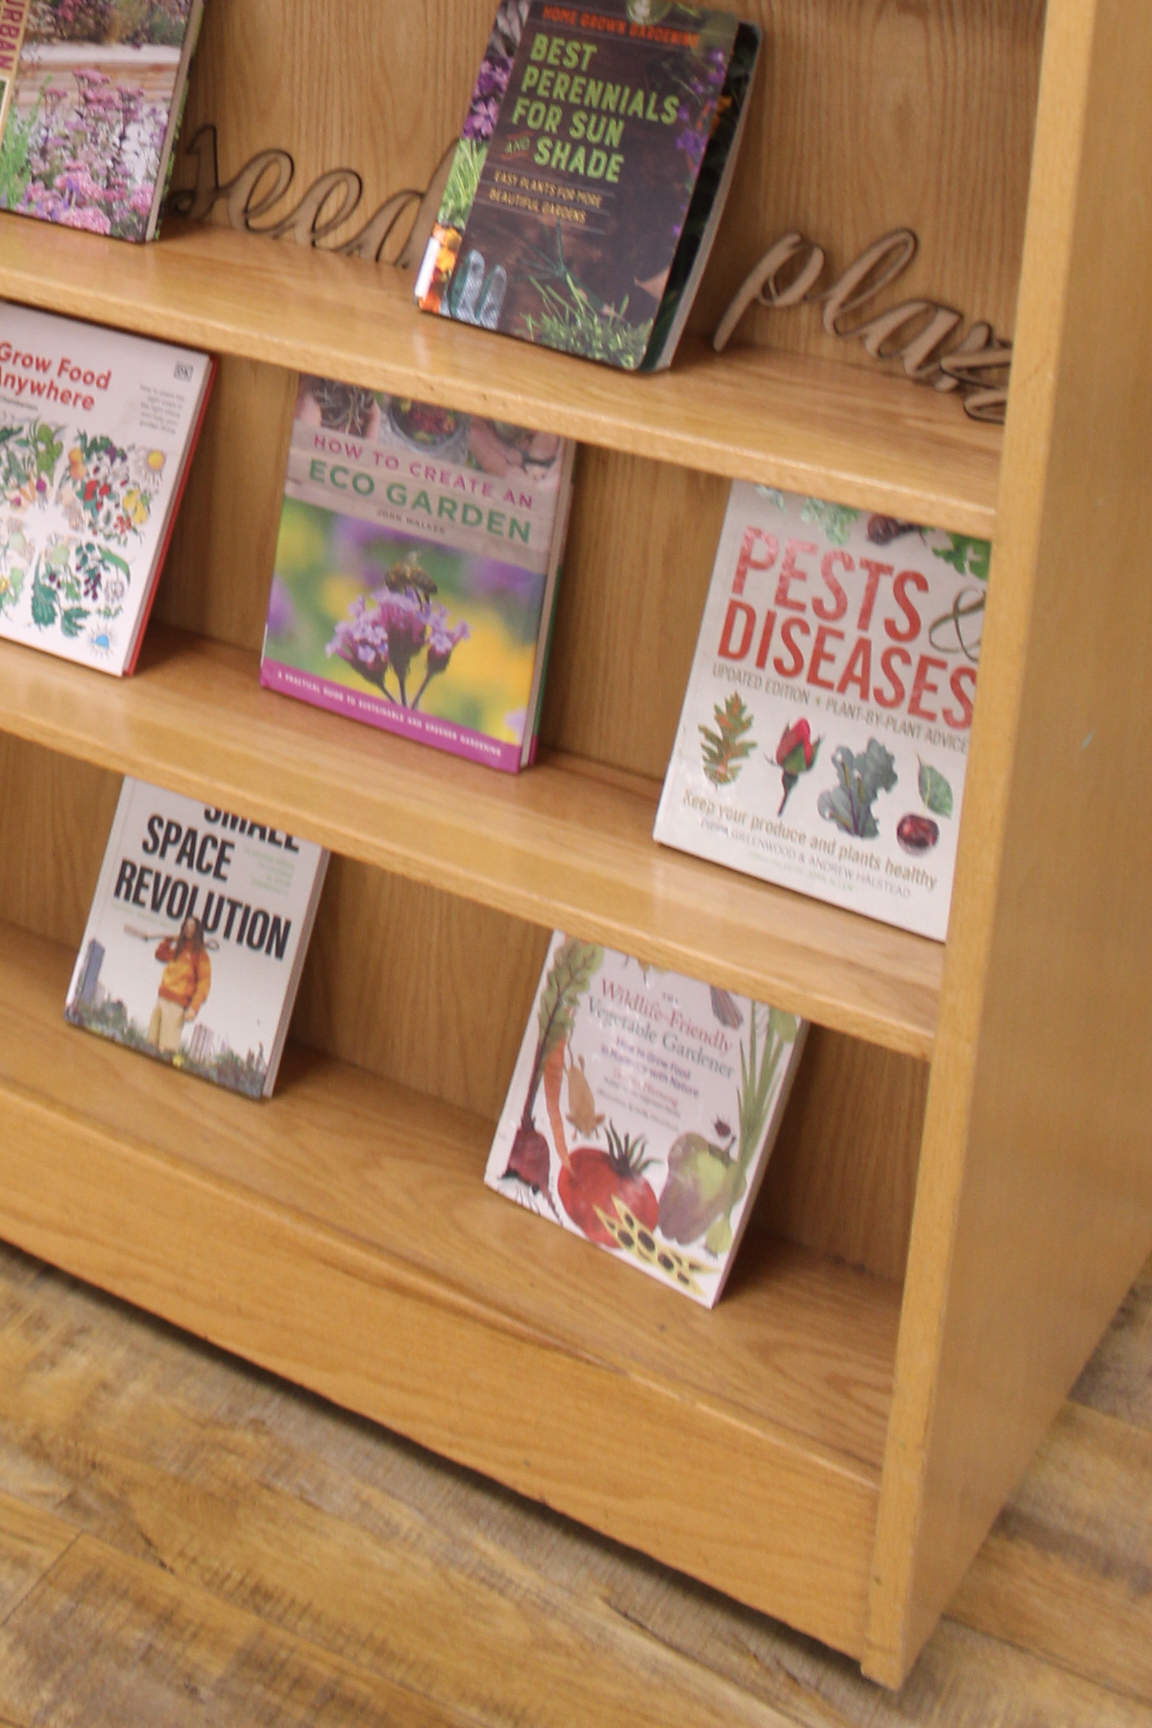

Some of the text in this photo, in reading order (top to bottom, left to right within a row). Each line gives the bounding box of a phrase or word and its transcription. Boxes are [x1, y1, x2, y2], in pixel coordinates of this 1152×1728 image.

[529, 32, 598, 72] BEST
[541, 4, 702, 50] HOME GROWN GARDENING
[510, 96, 626, 149] FOR SUN
[520, 65, 680, 126] PERENNIALS
[493, 168, 518, 187] EASY
[518, 175, 557, 198] PLANTS
[556, 184, 576, 202] FOR
[504, 135, 626, 184] AND SHADE
[488, 186, 586, 225] BEAUTIFUL GARDENS
[56, 357, 112, 391] Food
[308, 457, 532, 545] ECO GARDEN
[313, 434, 534, 511] HOW TO CREATE AN
[730, 525, 930, 644] PESTS
[712, 662, 764, 690] UPDATED
[765, 677, 810, 706] EDITION
[825, 698, 922, 739] PLANT-BY-PLANT
[716, 596, 979, 732] DISEASES
[141, 813, 236, 883] SPACE
[682, 788, 715, 818] Keep
[716, 803, 750, 828] your
[750, 816, 807, 845] produce
[808, 835, 837, 858] and
[838, 843, 882, 873] plants
[884, 855, 938, 892] healthy
[112, 857, 292, 962] REVOLUTION
[588, 994, 736, 1080] Vegetable Gardener
[600, 976, 733, 1056] Wildlife-Friendly
